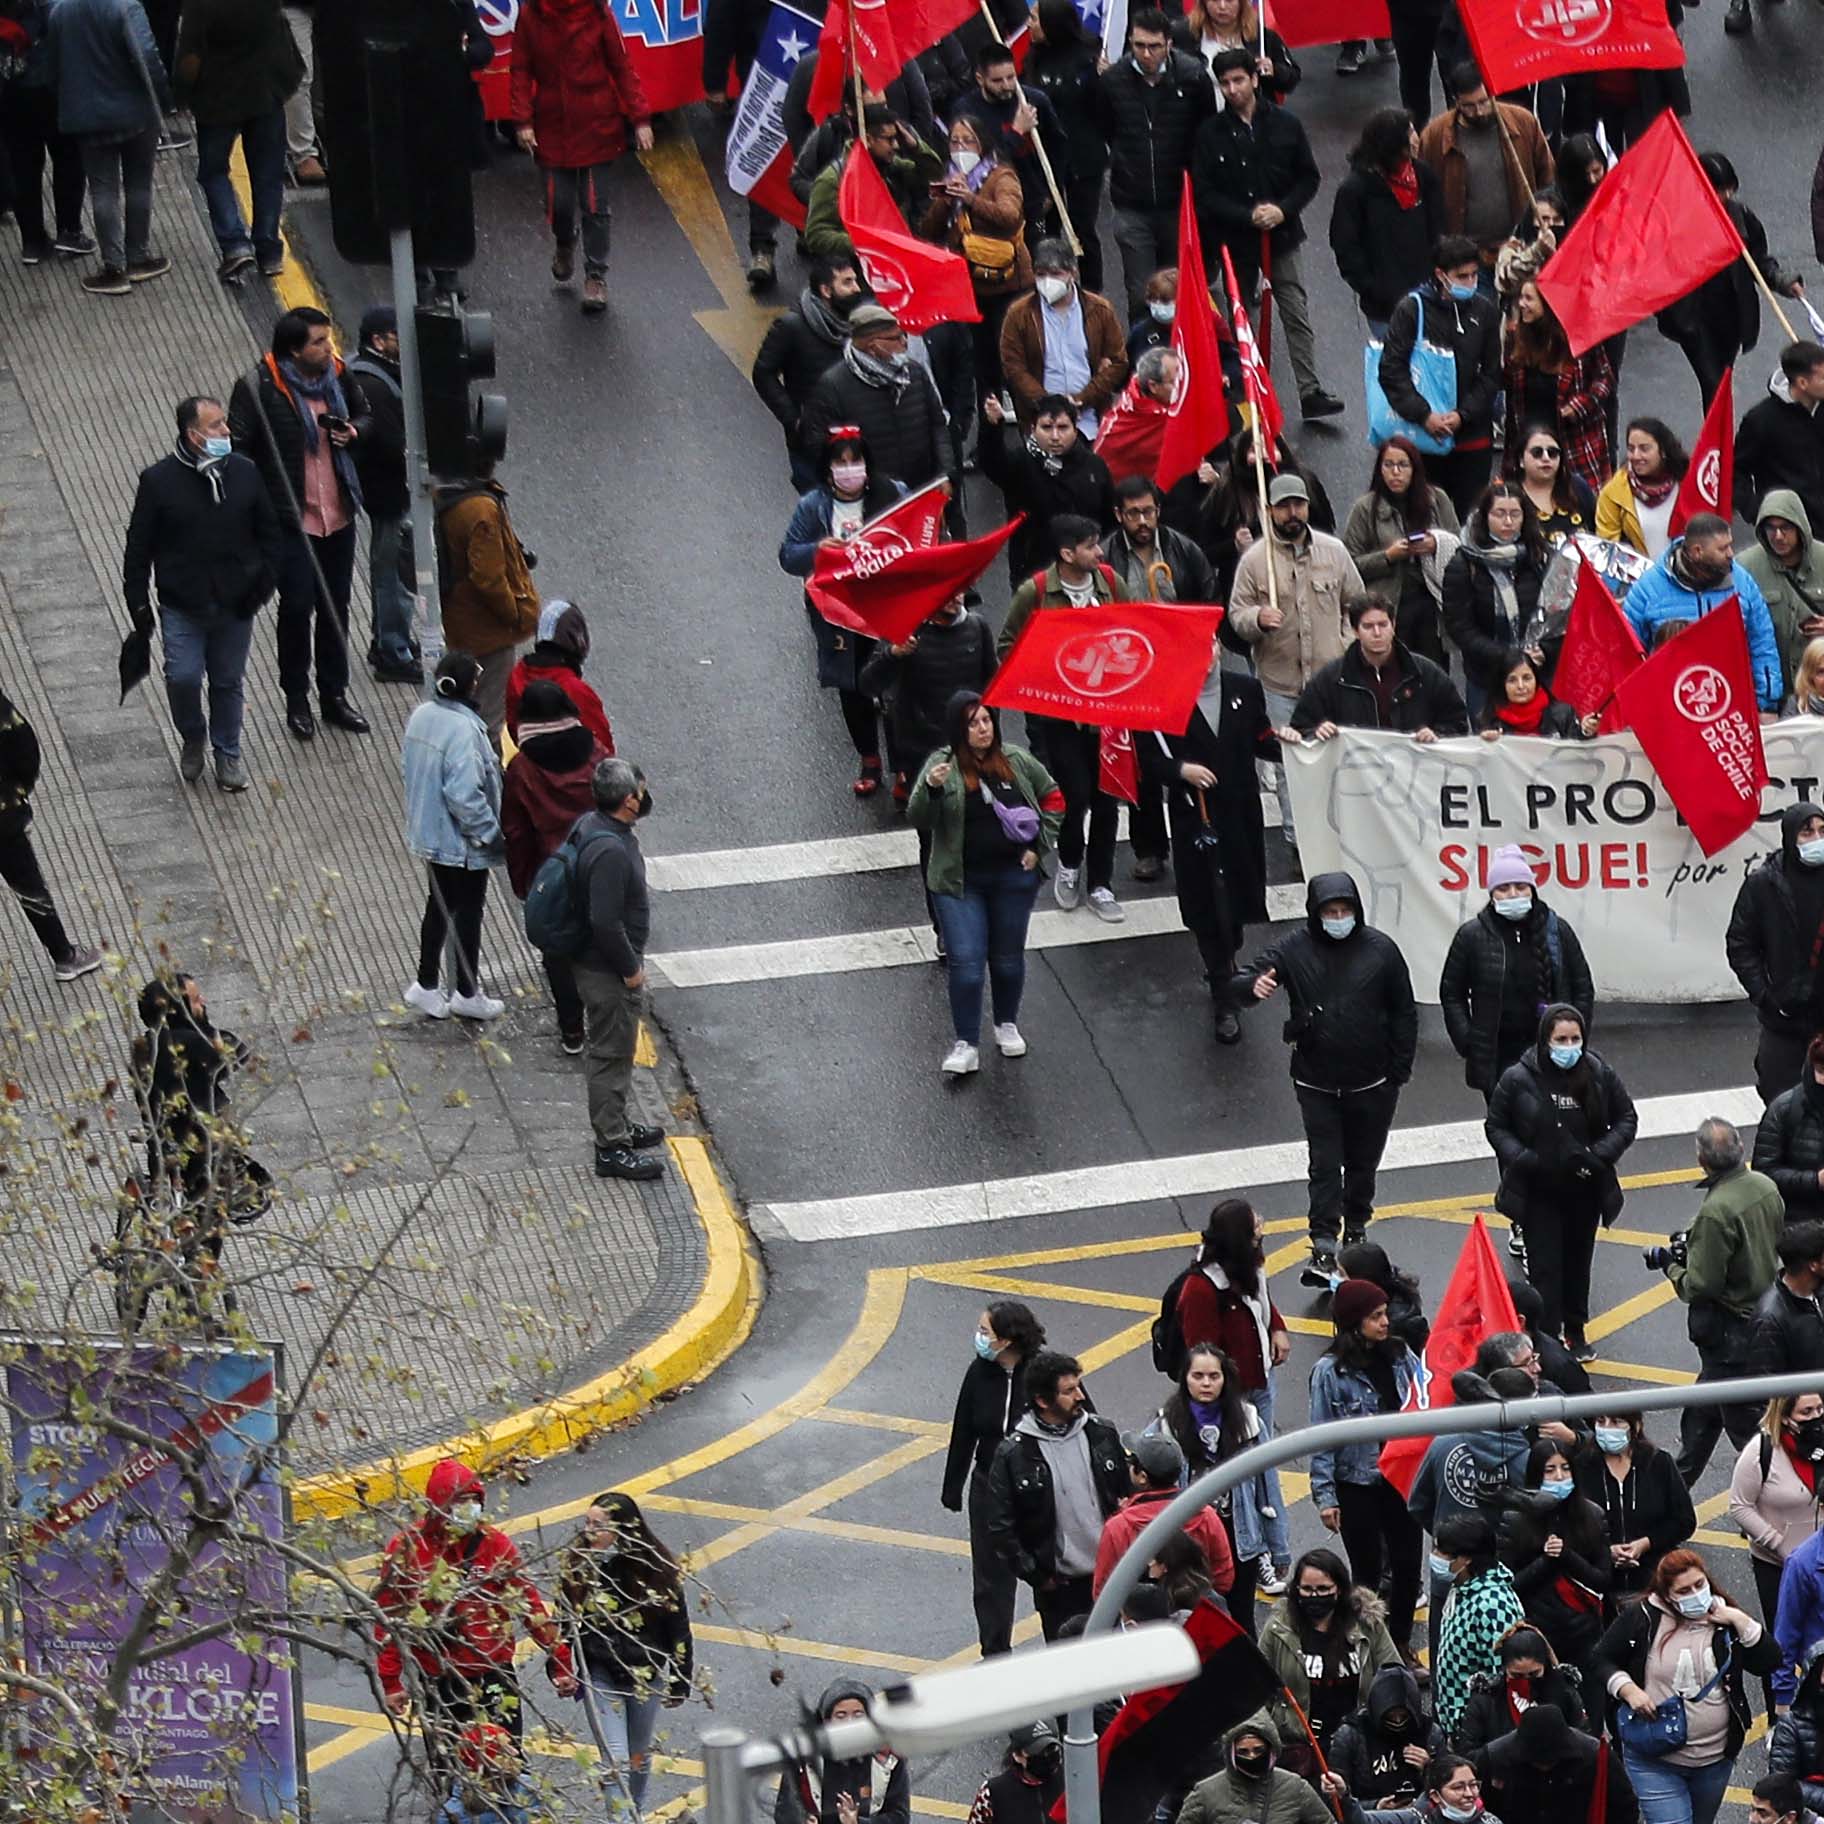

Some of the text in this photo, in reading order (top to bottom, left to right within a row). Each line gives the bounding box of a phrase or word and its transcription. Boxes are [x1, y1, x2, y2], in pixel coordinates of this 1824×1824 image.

[1718, 750, 1754, 800] CHILE
[1441, 784, 1502, 829] EL
[1667, 858, 1727, 897] por
